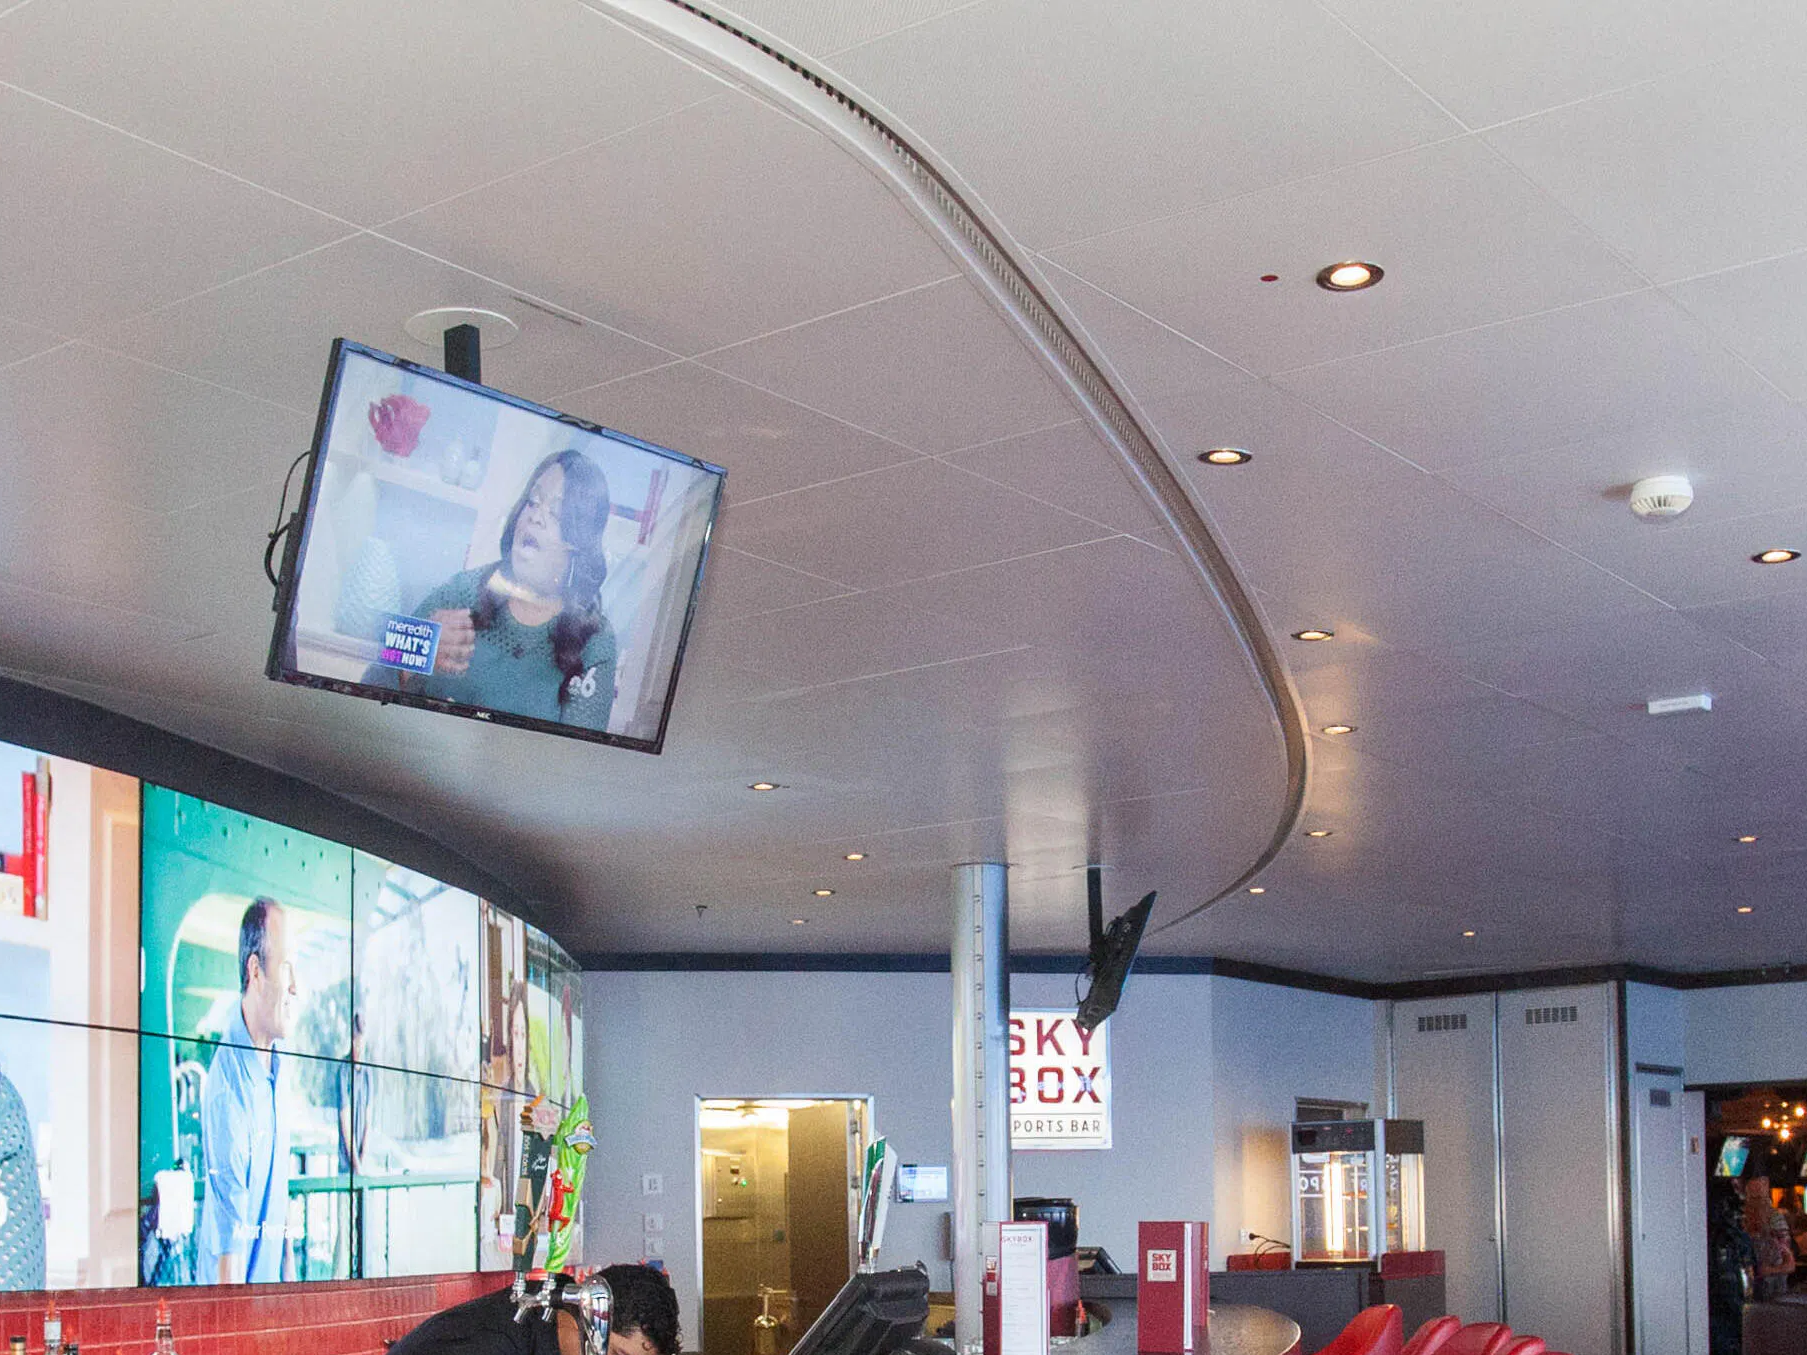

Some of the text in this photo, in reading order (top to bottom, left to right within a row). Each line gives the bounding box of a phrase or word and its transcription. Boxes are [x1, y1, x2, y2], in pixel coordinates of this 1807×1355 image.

[387, 620, 433, 638] meredith
[386, 631, 430, 655] WHAT'S
[1013, 1119, 1101, 1133] PORTS BAR
[1153, 1253, 1171, 1261] SKY
